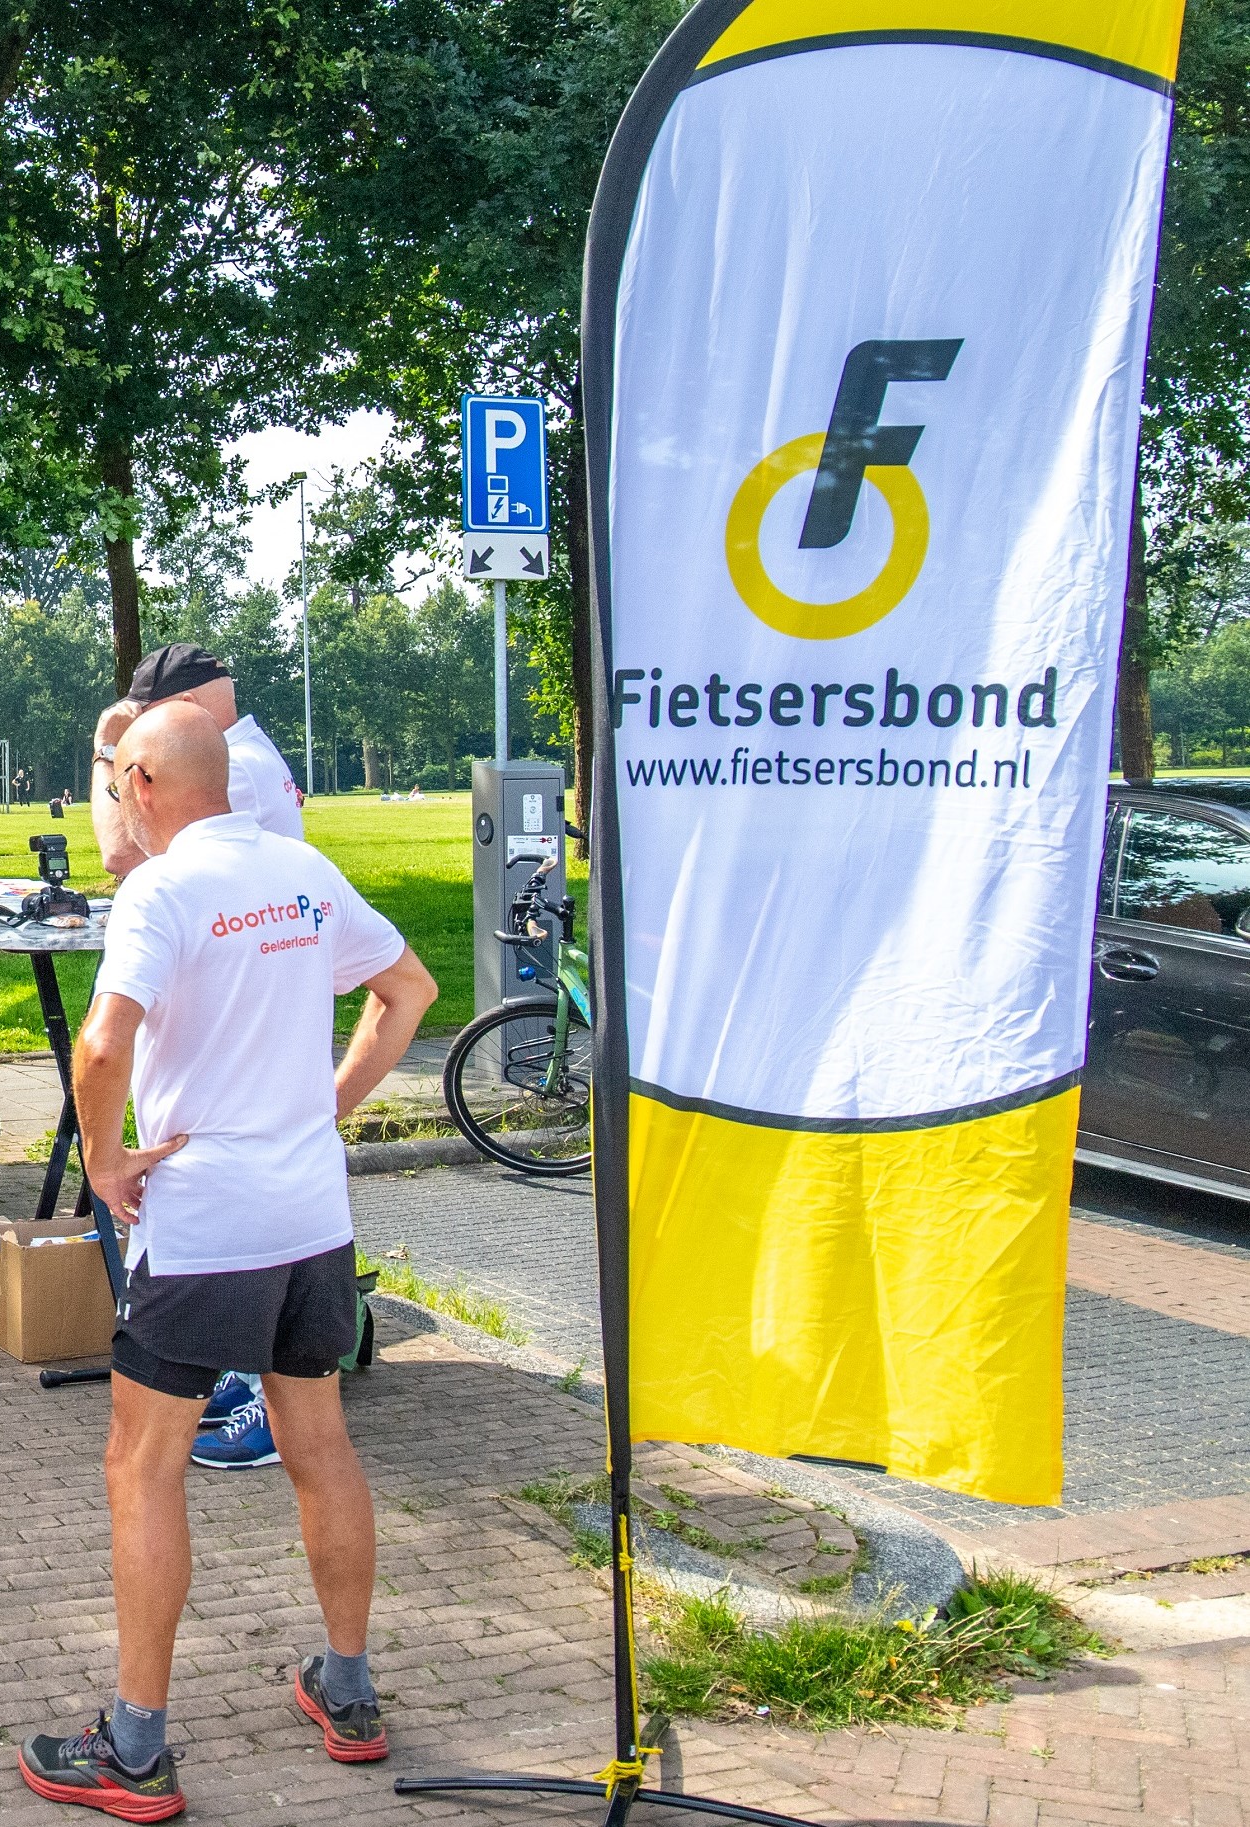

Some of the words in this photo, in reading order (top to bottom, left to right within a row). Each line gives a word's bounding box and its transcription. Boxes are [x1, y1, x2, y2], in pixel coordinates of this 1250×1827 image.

[485, 408, 527, 474] P
[613, 666, 1058, 729] Fietsersbond
[626, 747, 1031, 788] www.fietsersbond.nl
[211, 894, 335, 938] doortrappen
[260, 933, 319, 955] Gelderland
